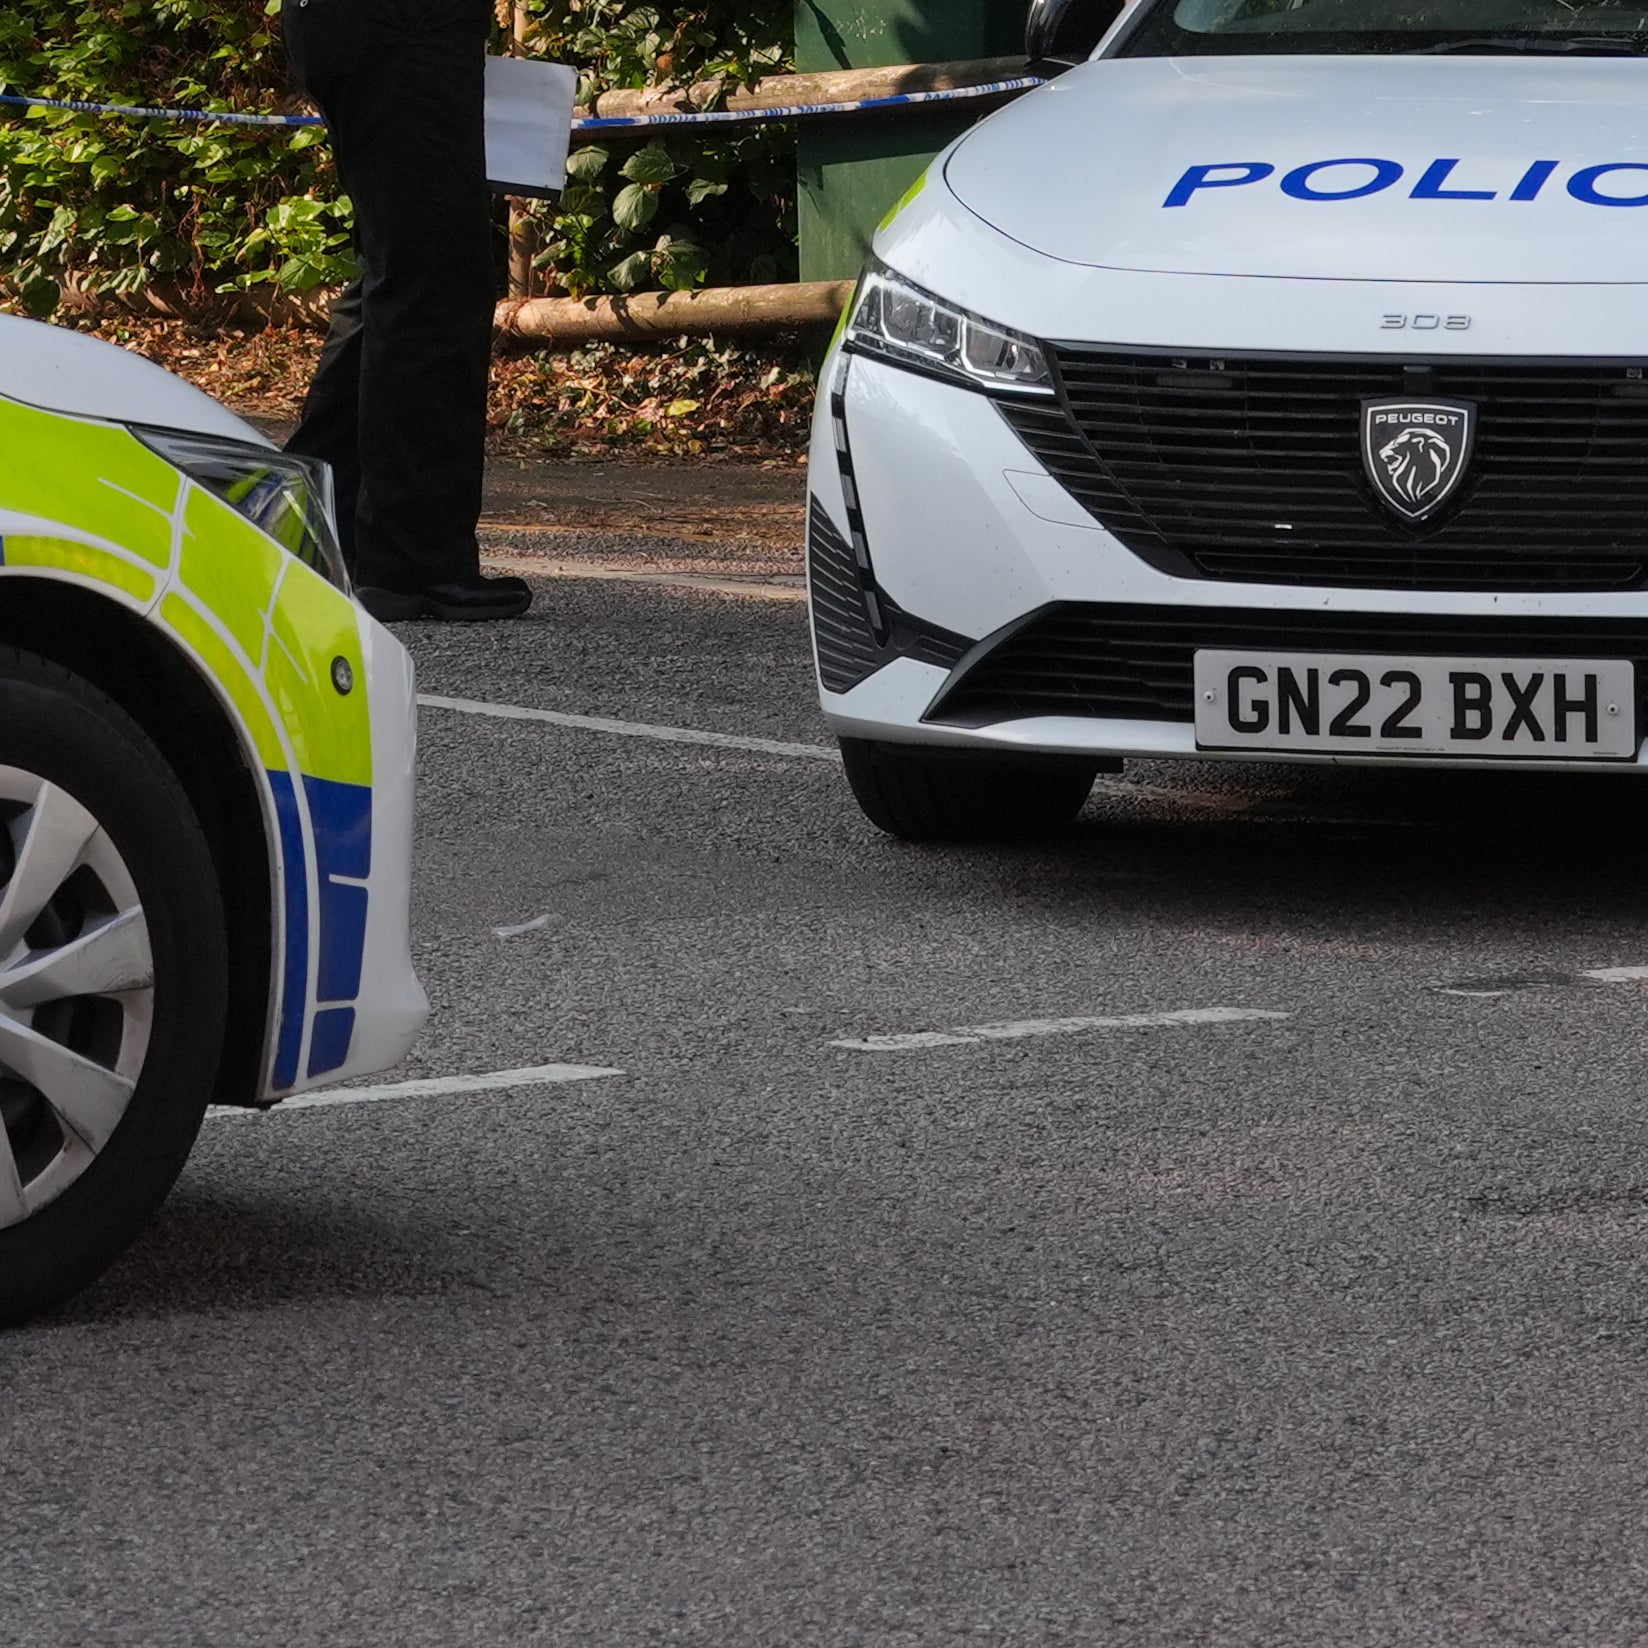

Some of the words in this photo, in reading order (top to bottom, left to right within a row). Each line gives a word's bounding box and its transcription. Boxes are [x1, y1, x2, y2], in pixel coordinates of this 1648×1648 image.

[1379, 313, 1473, 331] 308
[1373, 411, 1461, 427] PEUGEOT
[1226, 665, 1425, 740] GN22
[1446, 670, 1601, 744] BXH
